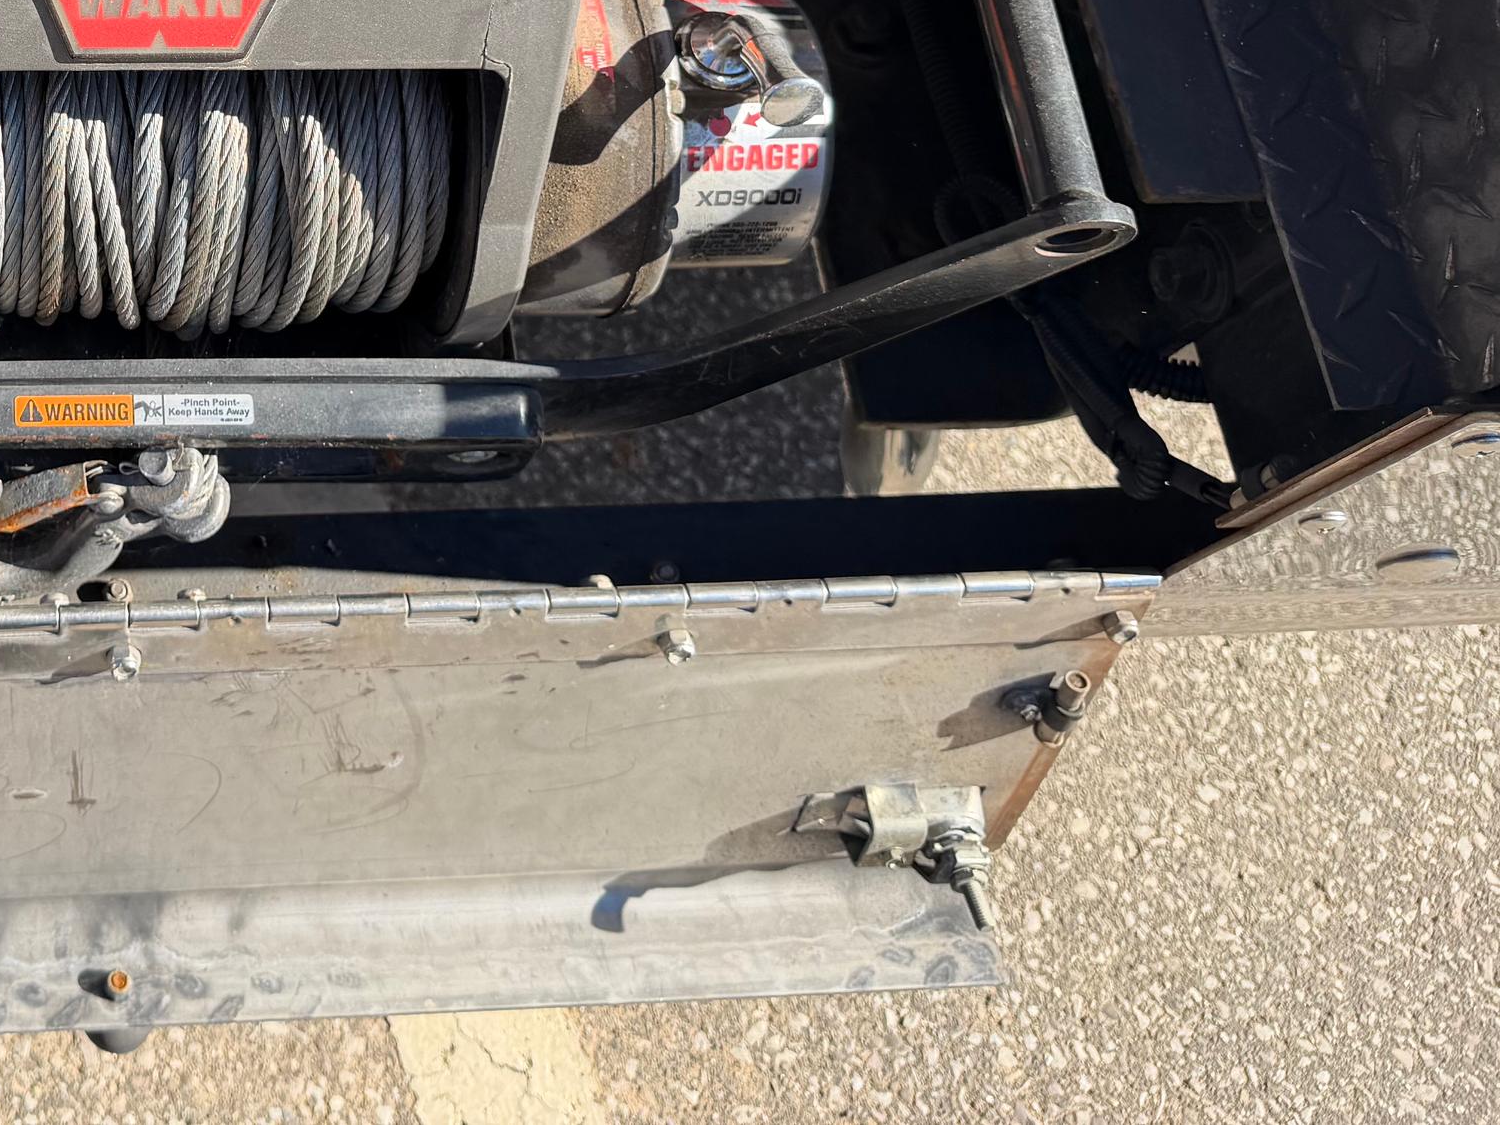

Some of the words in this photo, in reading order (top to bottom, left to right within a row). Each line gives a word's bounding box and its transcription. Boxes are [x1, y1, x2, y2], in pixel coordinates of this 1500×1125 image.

[685, 142, 820, 172] ENGAGED
[695, 188, 802, 206] XD9000i
[45, 402, 129, 421] WARNING
[169, 407, 192, 418] Keep
[194, 407, 224, 416] Hands
[226, 407, 250, 418] Away
